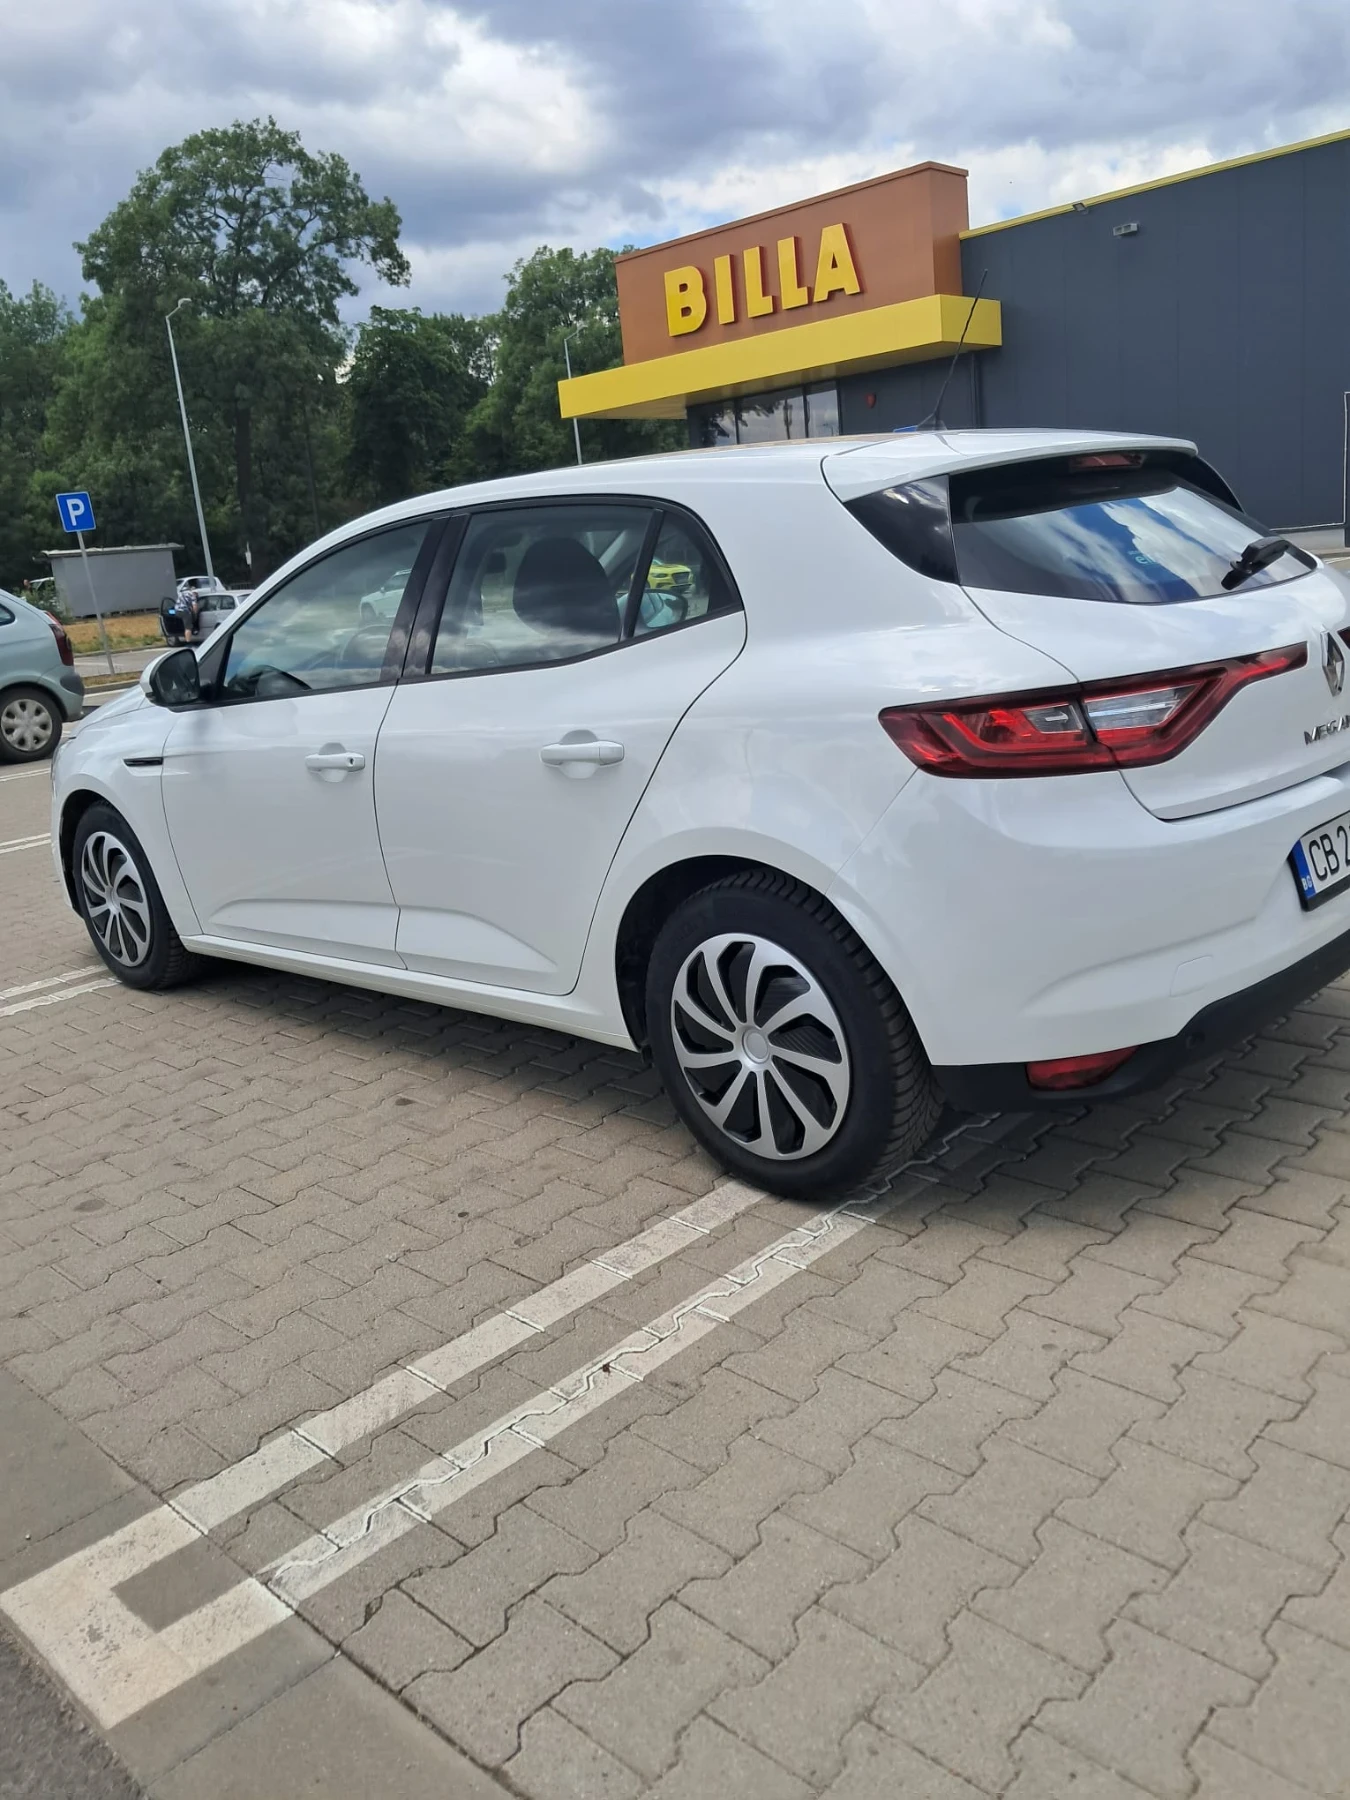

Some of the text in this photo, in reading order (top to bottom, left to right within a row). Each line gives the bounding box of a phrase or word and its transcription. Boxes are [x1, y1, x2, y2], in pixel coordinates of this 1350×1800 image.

[664, 222, 861, 337] BILLA
[66, 498, 85, 526] P
[1336, 825, 1350, 867] 2
[1301, 875, 1313, 891] BG
